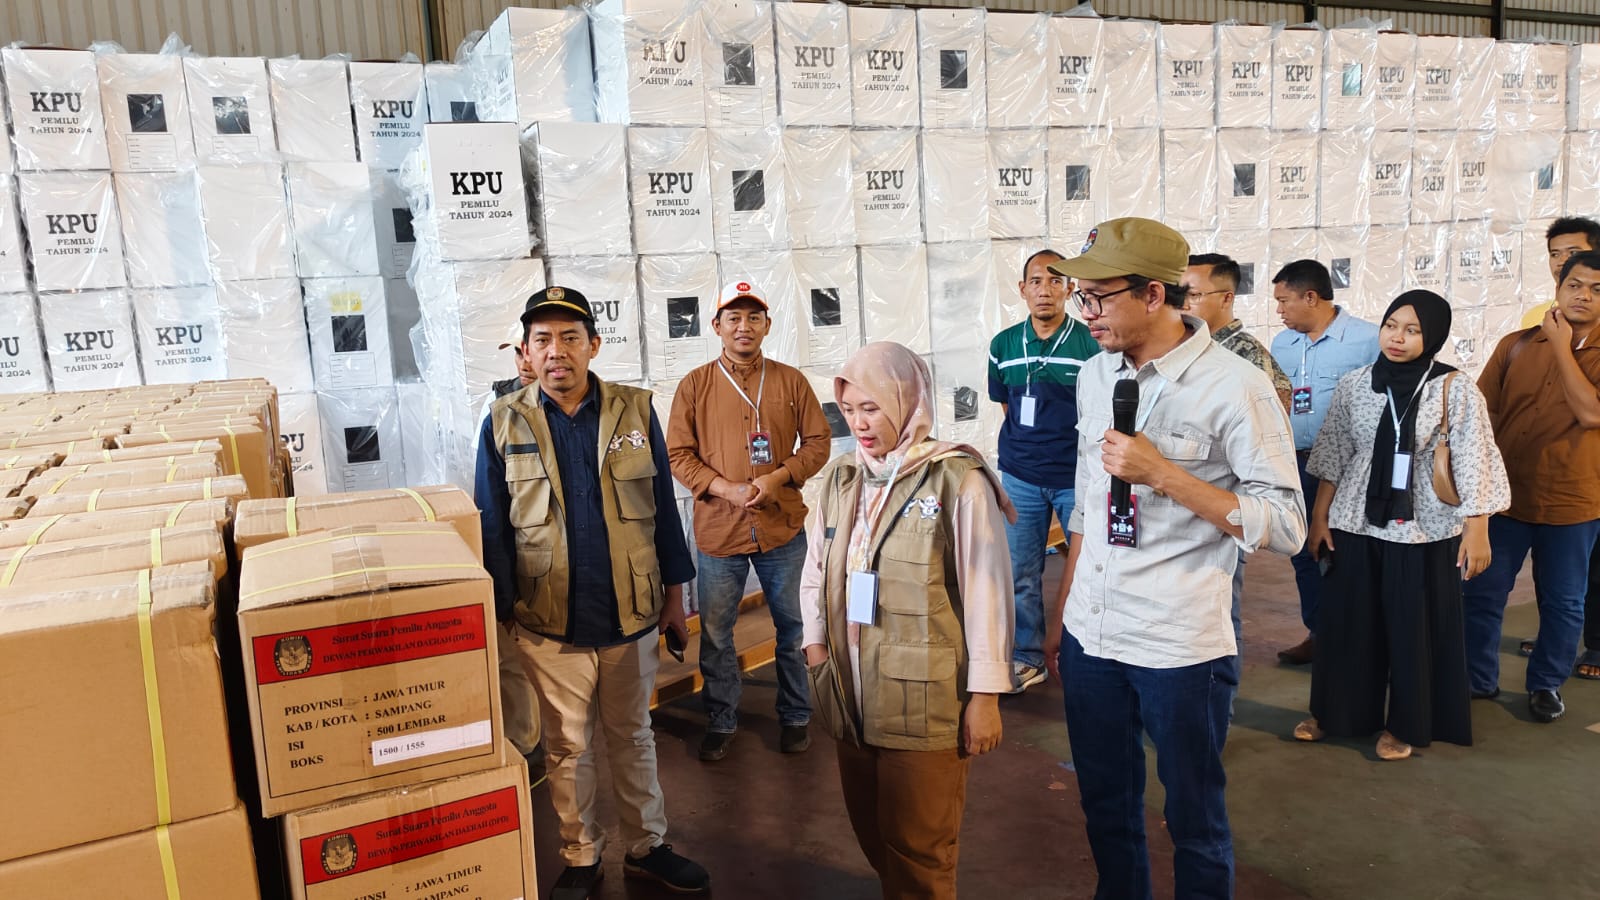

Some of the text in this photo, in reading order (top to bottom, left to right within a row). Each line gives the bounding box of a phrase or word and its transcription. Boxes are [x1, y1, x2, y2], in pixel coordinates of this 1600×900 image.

[794, 46, 835, 68] KPU
[866, 50, 904, 71] KPU
[801, 72, 831, 80] PEMILU
[1173, 60, 1203, 78] KPU
[1232, 61, 1261, 79] KPU
[1285, 65, 1314, 82] KPU
[1379, 66, 1405, 83] KPU
[1425, 68, 1451, 85] KPU
[792, 81, 841, 90] TAHUN 2024
[1501, 73, 1524, 89] KPU
[1536, 74, 1558, 90] KPU
[30, 92, 82, 113] KPU
[372, 100, 414, 119] KPU
[40, 117, 79, 125] PEMILU
[29, 126, 65, 134] TAHUN
[998, 168, 1033, 186] KPU
[1280, 166, 1308, 183] KPU
[1375, 163, 1402, 180] KPU
[1462, 161, 1485, 178] KPU
[450, 172, 503, 195] KPU
[649, 172, 693, 194] KPU
[866, 170, 904, 190] KPU
[461, 200, 499, 209] PEMILU
[656, 198, 690, 206] PEMILU
[872, 193, 901, 201] PEMILU
[449, 210, 513, 220] TAHUN 2024
[646, 208, 700, 217] TAHUN 2024
[864, 203, 890, 211] TAHUN
[46, 214, 98, 234] KPU
[57, 238, 95, 246] PEMILU
[46, 248, 81, 256] TAHUN
[590, 300, 620, 321] PU
[64, 330, 115, 352] KPU
[156, 325, 203, 346] KPU
[605, 336, 627, 344] 2024
[75, 353, 111, 363] PEMILU
[155, 354, 212, 366] TAHUN 2024
[165, 348, 200, 357] PEMILU
[6, 369, 31, 378] 2024
[64, 361, 124, 373] TAHUN 2024
[332, 618, 462, 645] Surat Suara Pemilu Anggota
[323, 632, 476, 663] DEWAN PERWAKILAN DAERAH (DPD)
[284, 680, 446, 717] PROVINSI : JAWA TIMUR
[286, 700, 432, 734] KAB / KOTA : SAMPANG
[288, 714, 447, 752] ISI : 500 LEMBAR
[290, 755, 324, 769] BOKS
[378, 745, 399, 757] 1500
[406, 740, 426, 752] 1555
[376, 802, 497, 840] Surat Suara Pemilu Anggota
[368, 845, 399, 859] DEWAN
[400, 830, 455, 850] PERWAKILAN
[456, 822, 488, 835] DAERAH
[353, 890, 387, 900] VINSI
[414, 877, 444, 892] JAWA
[446, 864, 482, 882] TIMUR
